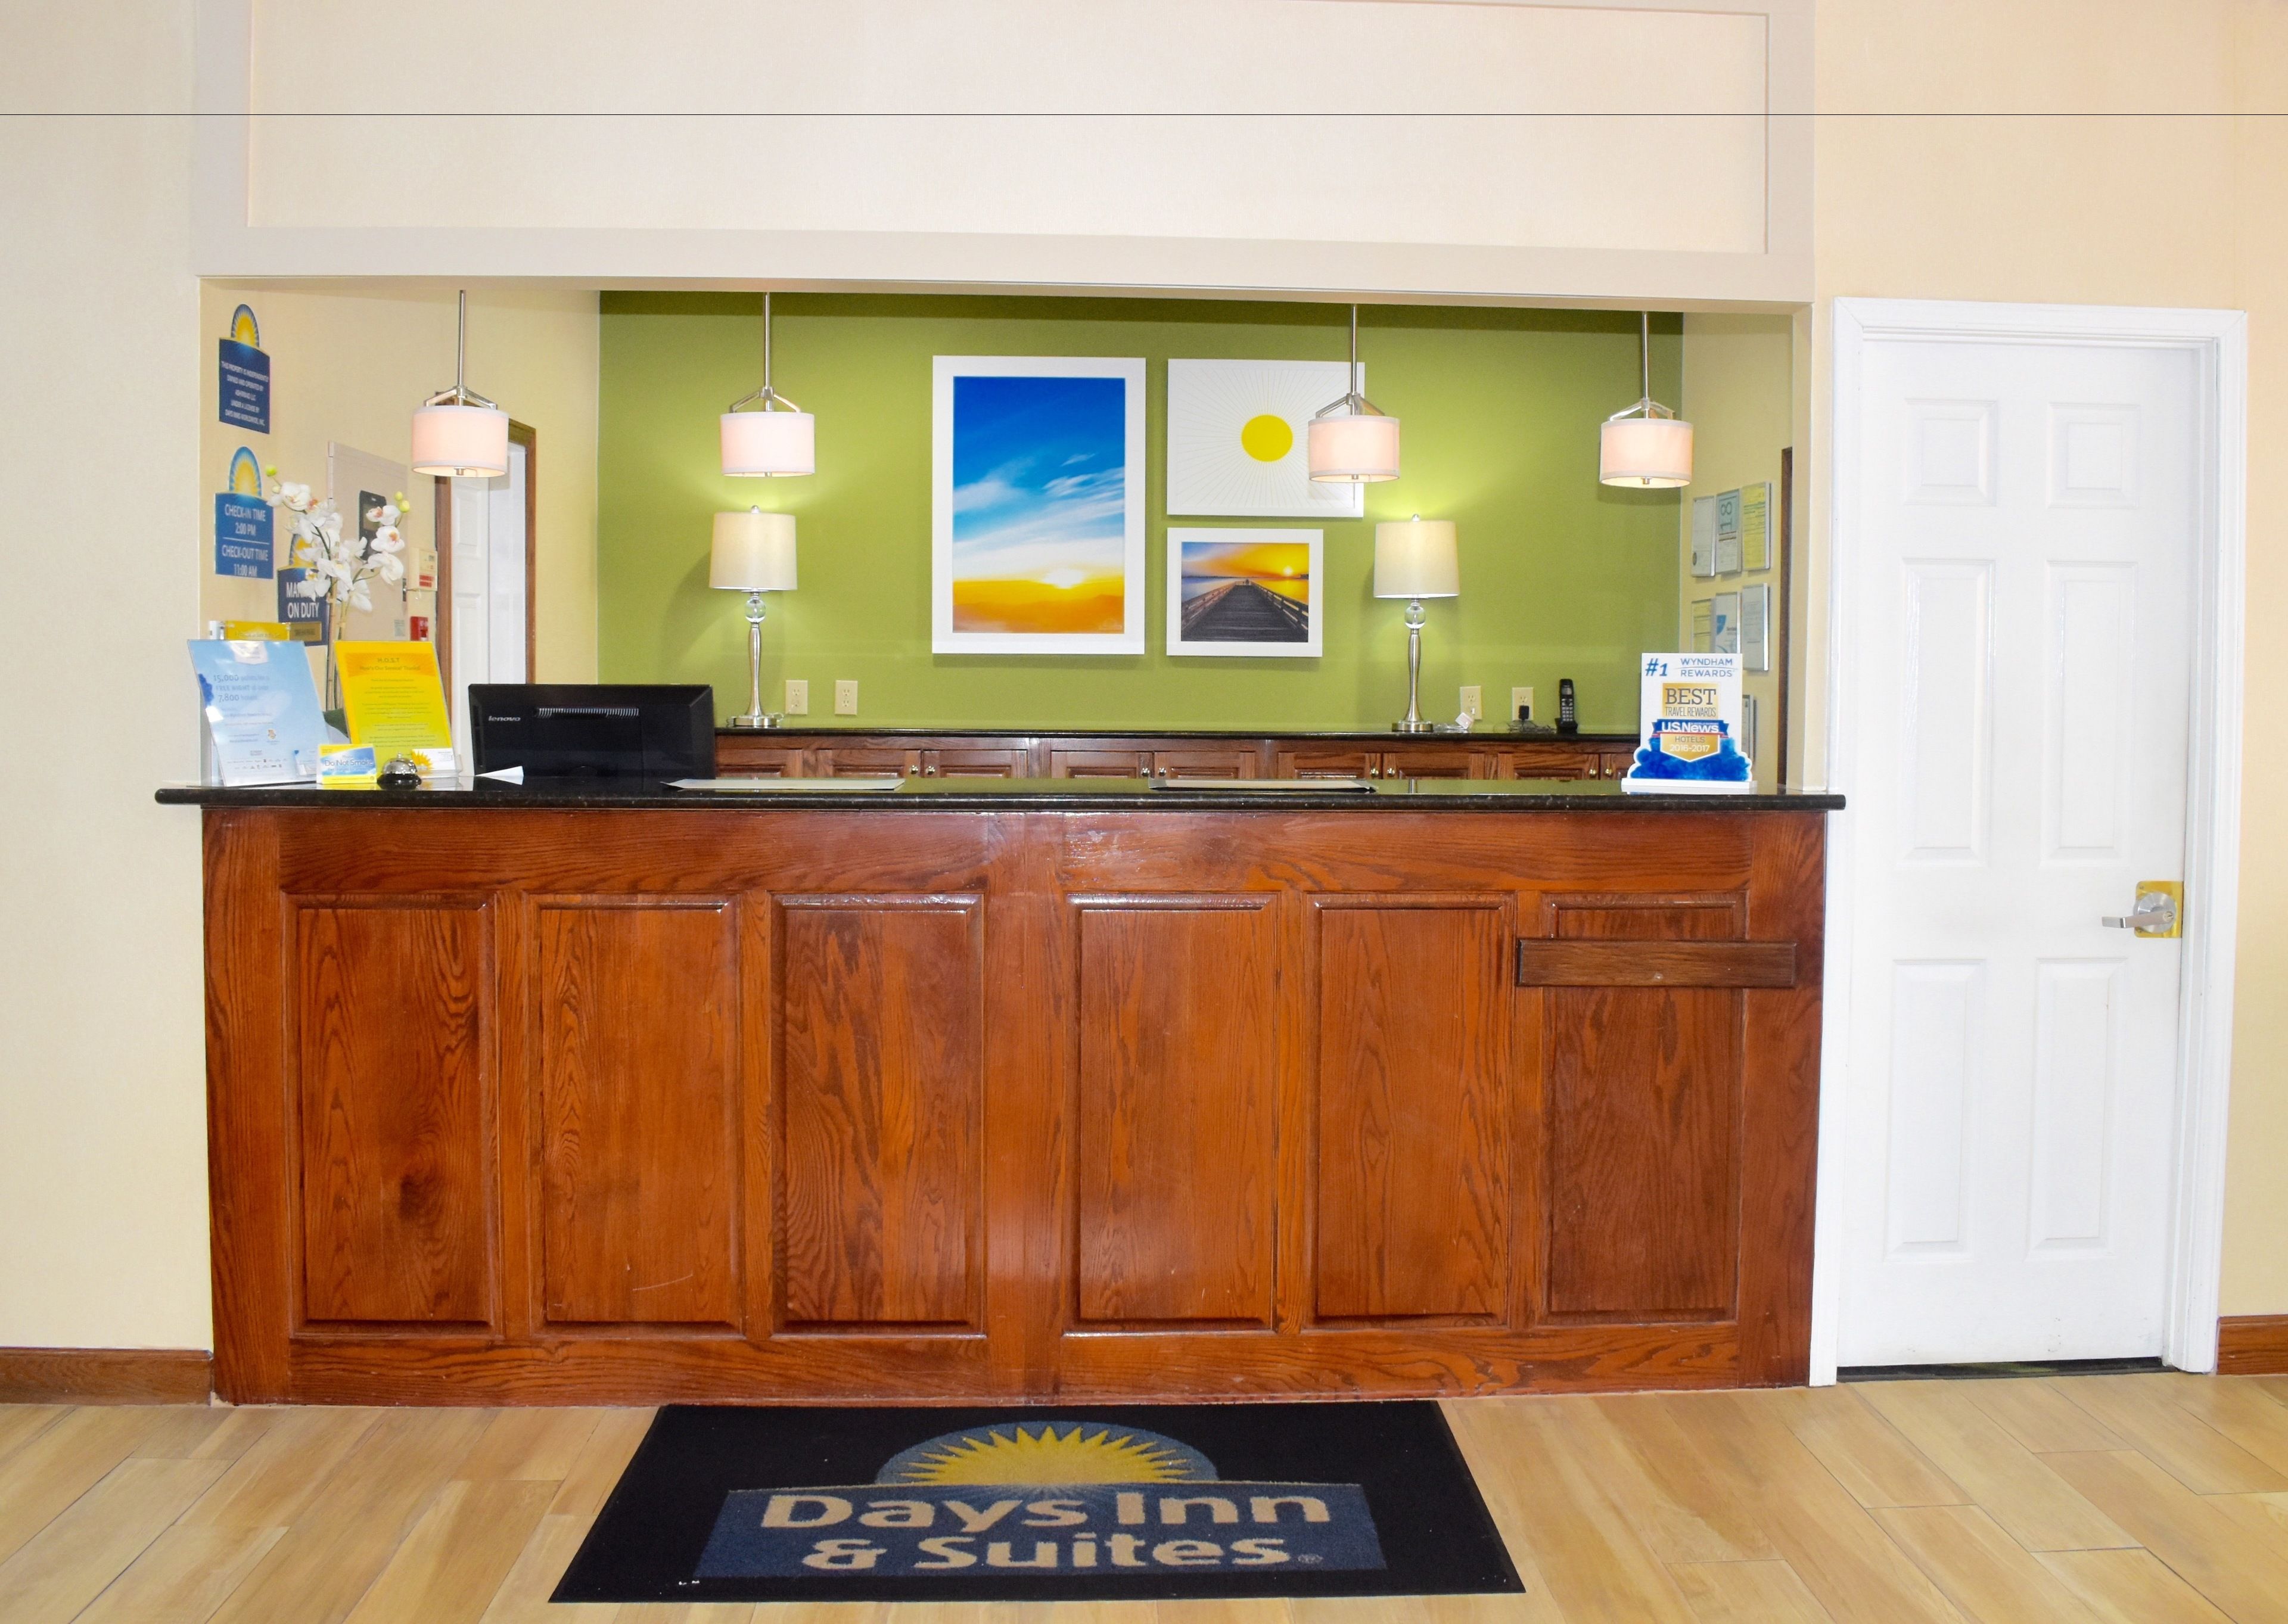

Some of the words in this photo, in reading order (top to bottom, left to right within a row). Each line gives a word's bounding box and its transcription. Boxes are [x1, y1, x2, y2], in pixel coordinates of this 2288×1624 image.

[225, 503, 252, 519] CHECK-IN
[252, 508, 266, 522] TIME
[235, 522, 247, 535] 2:00
[247, 524, 256, 536] PM
[222, 544, 254, 559] CHECK-OUT
[255, 549, 269, 561] TIME
[234, 564, 248, 576] 11:00
[248, 565, 257, 577] AM
[288, 602, 299, 618] ON
[301, 602, 319, 618] DUTY
[1645, 658, 1668, 677] #1
[1665, 688, 1717, 705] BEST
[1665, 707, 1687, 717] TRAVEL
[1687, 707, 1717, 717] REWARDS
[350, 757, 373, 766] Smoke
[760, 1495, 1088, 1533] Days
[1116, 1492, 1330, 1525] Inn
[801, 1539, 887, 1570] &
[913, 1532, 1291, 1569] Suites
